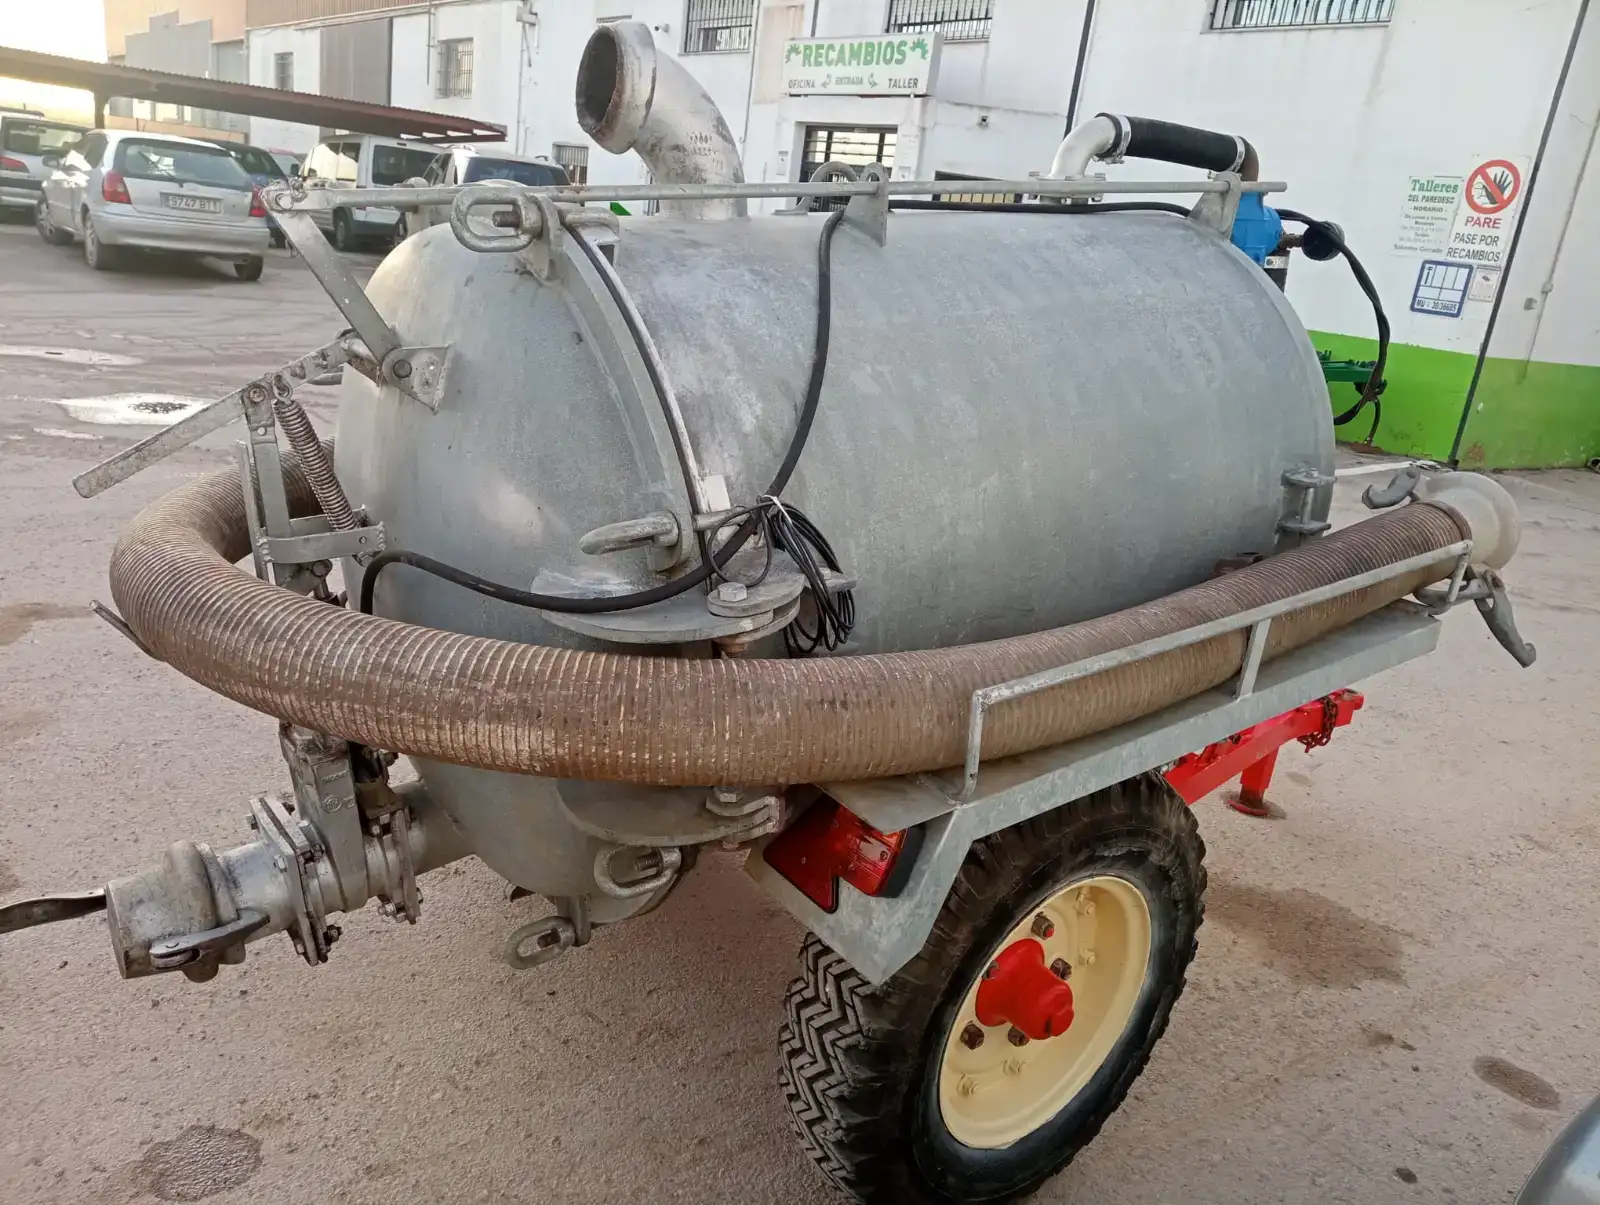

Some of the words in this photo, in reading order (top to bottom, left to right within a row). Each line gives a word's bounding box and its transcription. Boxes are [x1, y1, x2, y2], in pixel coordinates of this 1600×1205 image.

[801, 40, 908, 67] RECAMBIOS
[788, 79, 816, 89] OFICINA
[887, 78, 919, 89] TALLER
[1411, 179, 1459, 193] Talleres
[1465, 216, 1503, 229] PARE
[1453, 232, 1478, 245] PASE
[1479, 234, 1500, 247] POR
[1446, 247, 1501, 262] RECAMBIOS
